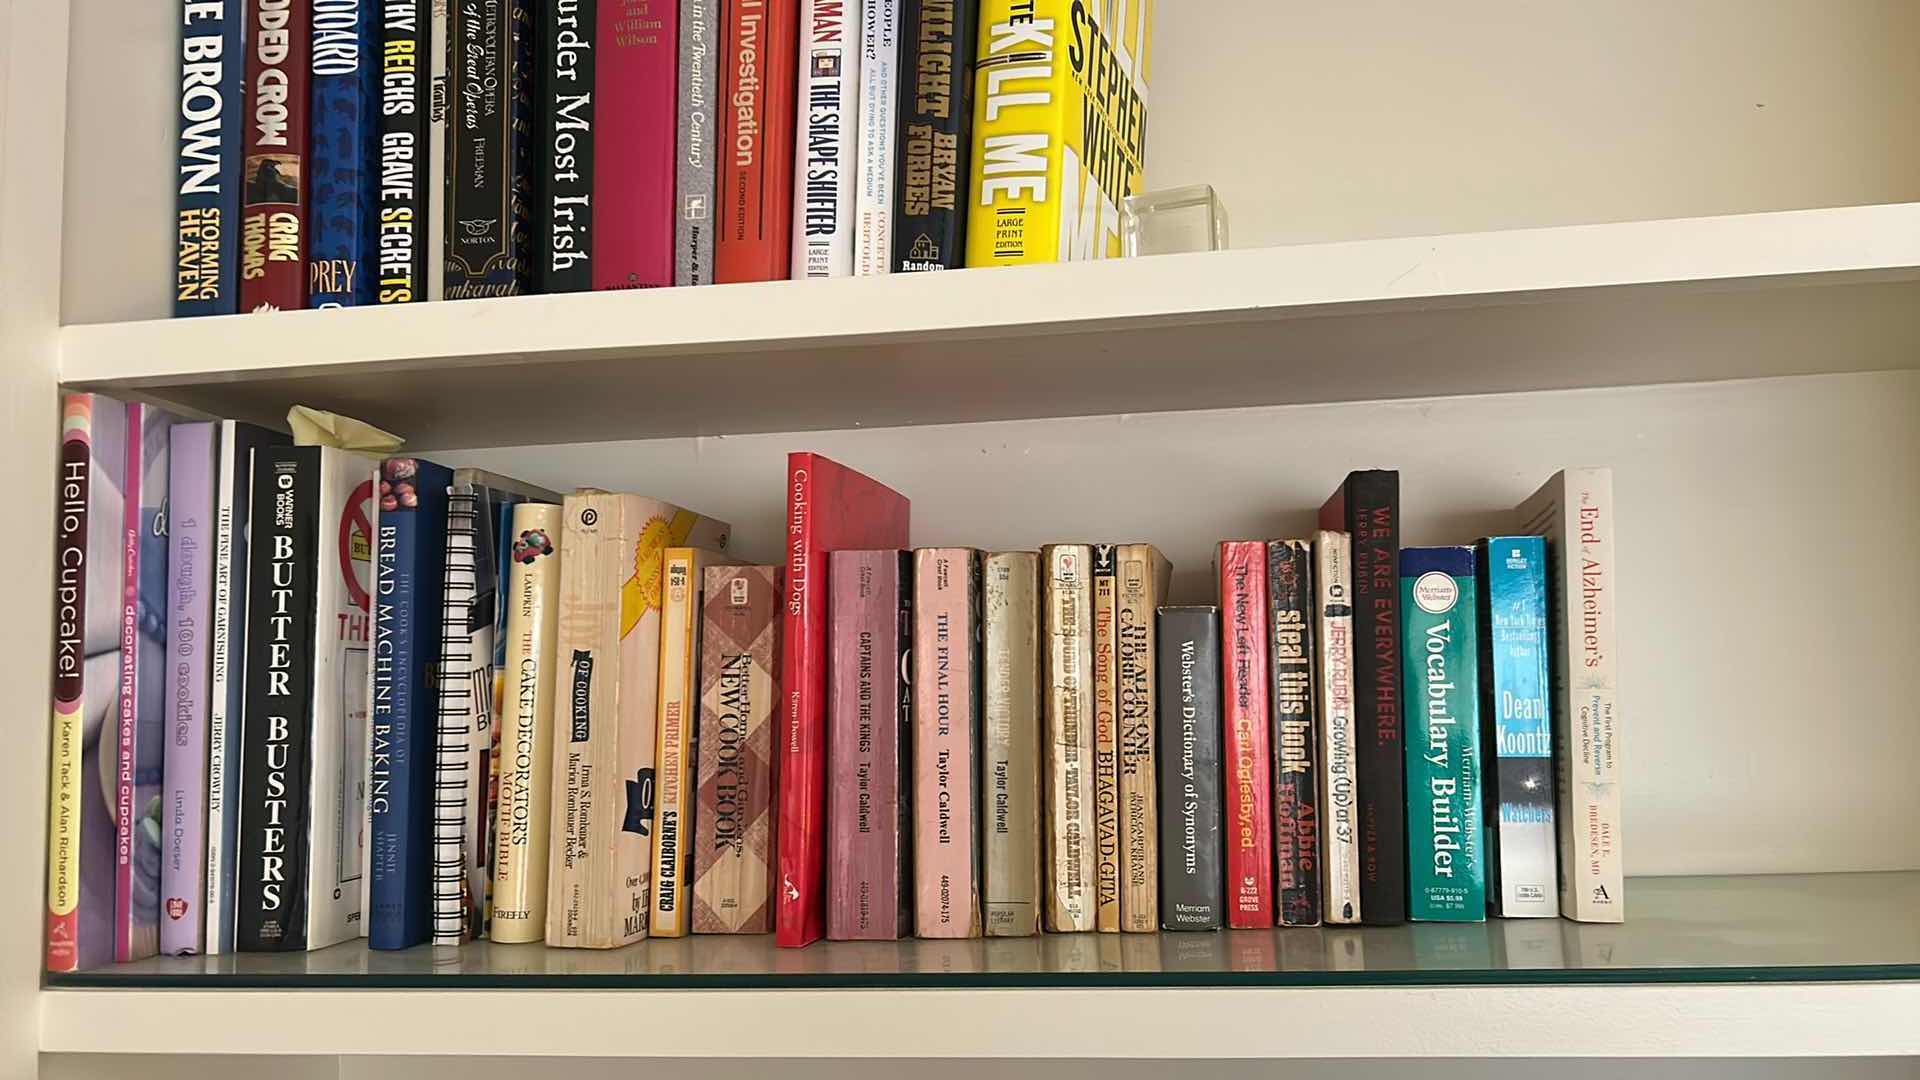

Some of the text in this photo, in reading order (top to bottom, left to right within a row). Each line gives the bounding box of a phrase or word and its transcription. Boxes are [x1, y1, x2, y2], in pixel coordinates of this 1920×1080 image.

[616, 35, 657, 47] Wilson
[179, 34, 224, 194] BROWN
[256, 68, 288, 146] CROW
[688, 44, 706, 168] Twentieth Century
[733, 15, 764, 166] Investigation
[378, 40, 417, 303] REICHS GRAVE SECRETS
[552, 92, 591, 272] Most Irish
[805, 80, 841, 236] THE SHAPE SHIFTER
[904, 125, 932, 217] FORBES
[931, 132, 958, 211] BRYAN
[980, 133, 1050, 207] ME
[178, 208, 201, 301] HEAVEN
[200, 208, 220, 300] STORMING
[243, 213, 267, 280] THOMAS
[268, 212, 299, 261] CRAIG
[996, 229, 1023, 239] PRINT
[997, 219, 1024, 227] LARGE
[310, 258, 357, 293] PREY
[275, 494, 285, 526] BOOKS
[284, 489, 294, 529] WARNER
[788, 469, 808, 616] Cooking with Dogs
[58, 461, 86, 678] Hello, Cupcake!
[215, 506, 231, 683] THE FINE ART OF GARNISHING
[379, 526, 397, 595] BREAD
[1580, 506, 1603, 668] End Alzheimer's
[175, 537, 198, 747] dough, 100 cookies
[267, 535, 296, 697] BUTTER
[1121, 608, 1136, 686] CALORIE
[1236, 564, 1253, 751] The New Left Reader Carl
[1331, 621, 1347, 668] JERRY
[1372, 506, 1397, 746] WE ARE EVERYWHERE.
[375, 604, 394, 714] MACHINE
[575, 660, 590, 740] OF COOKING
[1276, 610, 1311, 774] steal this book
[1332, 669, 1348, 710] RUBIN
[119, 605, 136, 865] decorating cakes and cupcakes
[511, 574, 537, 846] LAMPKIN THE CAKE DECORATOR'S
[738, 654, 753, 785] Better and
[790, 690, 801, 753] Karen Dowell
[855, 631, 872, 833] CAPTAINS AND THE KINGS Taylor Caldwell
[1122, 689, 1137, 775] COUNTER
[1332, 716, 1349, 775] Growing
[1496, 730, 1550, 757] Koontz
[1502, 690, 1542, 720] Dean
[1581, 706, 1591, 764] Cognitive Decline
[1592, 695, 1602, 775] Prevent and Reverse
[1603, 703, 1613, 760] The First Program
[211, 713, 224, 813] JERRY CROWLEY
[373, 724, 391, 814] BAKING
[569, 753, 581, 785] Marion
[714, 653, 742, 850] NEW COOK BOOK
[936, 612, 951, 923] THE FINAL HOUR Taylor Caldwell 449-02074-175
[1096, 607, 1116, 907] The Song of God BHAGAVAD-GITA
[1180, 639, 1199, 875] Webster's Dictionary of Synonyms
[1424, 620, 1461, 878] Vocabulary Builder
[58, 721, 72, 907] Karen Tack & Alan Richardson
[172, 790, 185, 871] Linda Doeser
[260, 716, 289, 911] BUSTERS
[498, 771, 514, 881] MOTIF BIBLE
[565, 787, 579, 834] Rombauer
[577, 765, 592, 859] Irma Rombauer &
[660, 700, 681, 912] CRAIG CLAIBORNE'S KITCHEN PRIMER
[994, 760, 1009, 833] Taylor Caldwell
[1137, 794, 1145, 861] JEAN CARPER
[1333, 776, 1352, 807] (Up)
[1501, 802, 1552, 825] Watchers
[564, 837, 577, 869] Becker
[1066, 823, 1081, 899] CALDWELL
[1129, 791, 1139, 887] PATRICIA KRAUSE
[1279, 783, 1297, 889] Hoffman
[1297, 800, 1315, 872] Abbie
[1338, 826, 1352, 844] 37
[492, 907, 531, 919] FIREFLY
[1175, 903, 1210, 912] Merriam
[1175, 914, 1210, 923] Webster
[1239, 903, 1259, 911] PRESS
